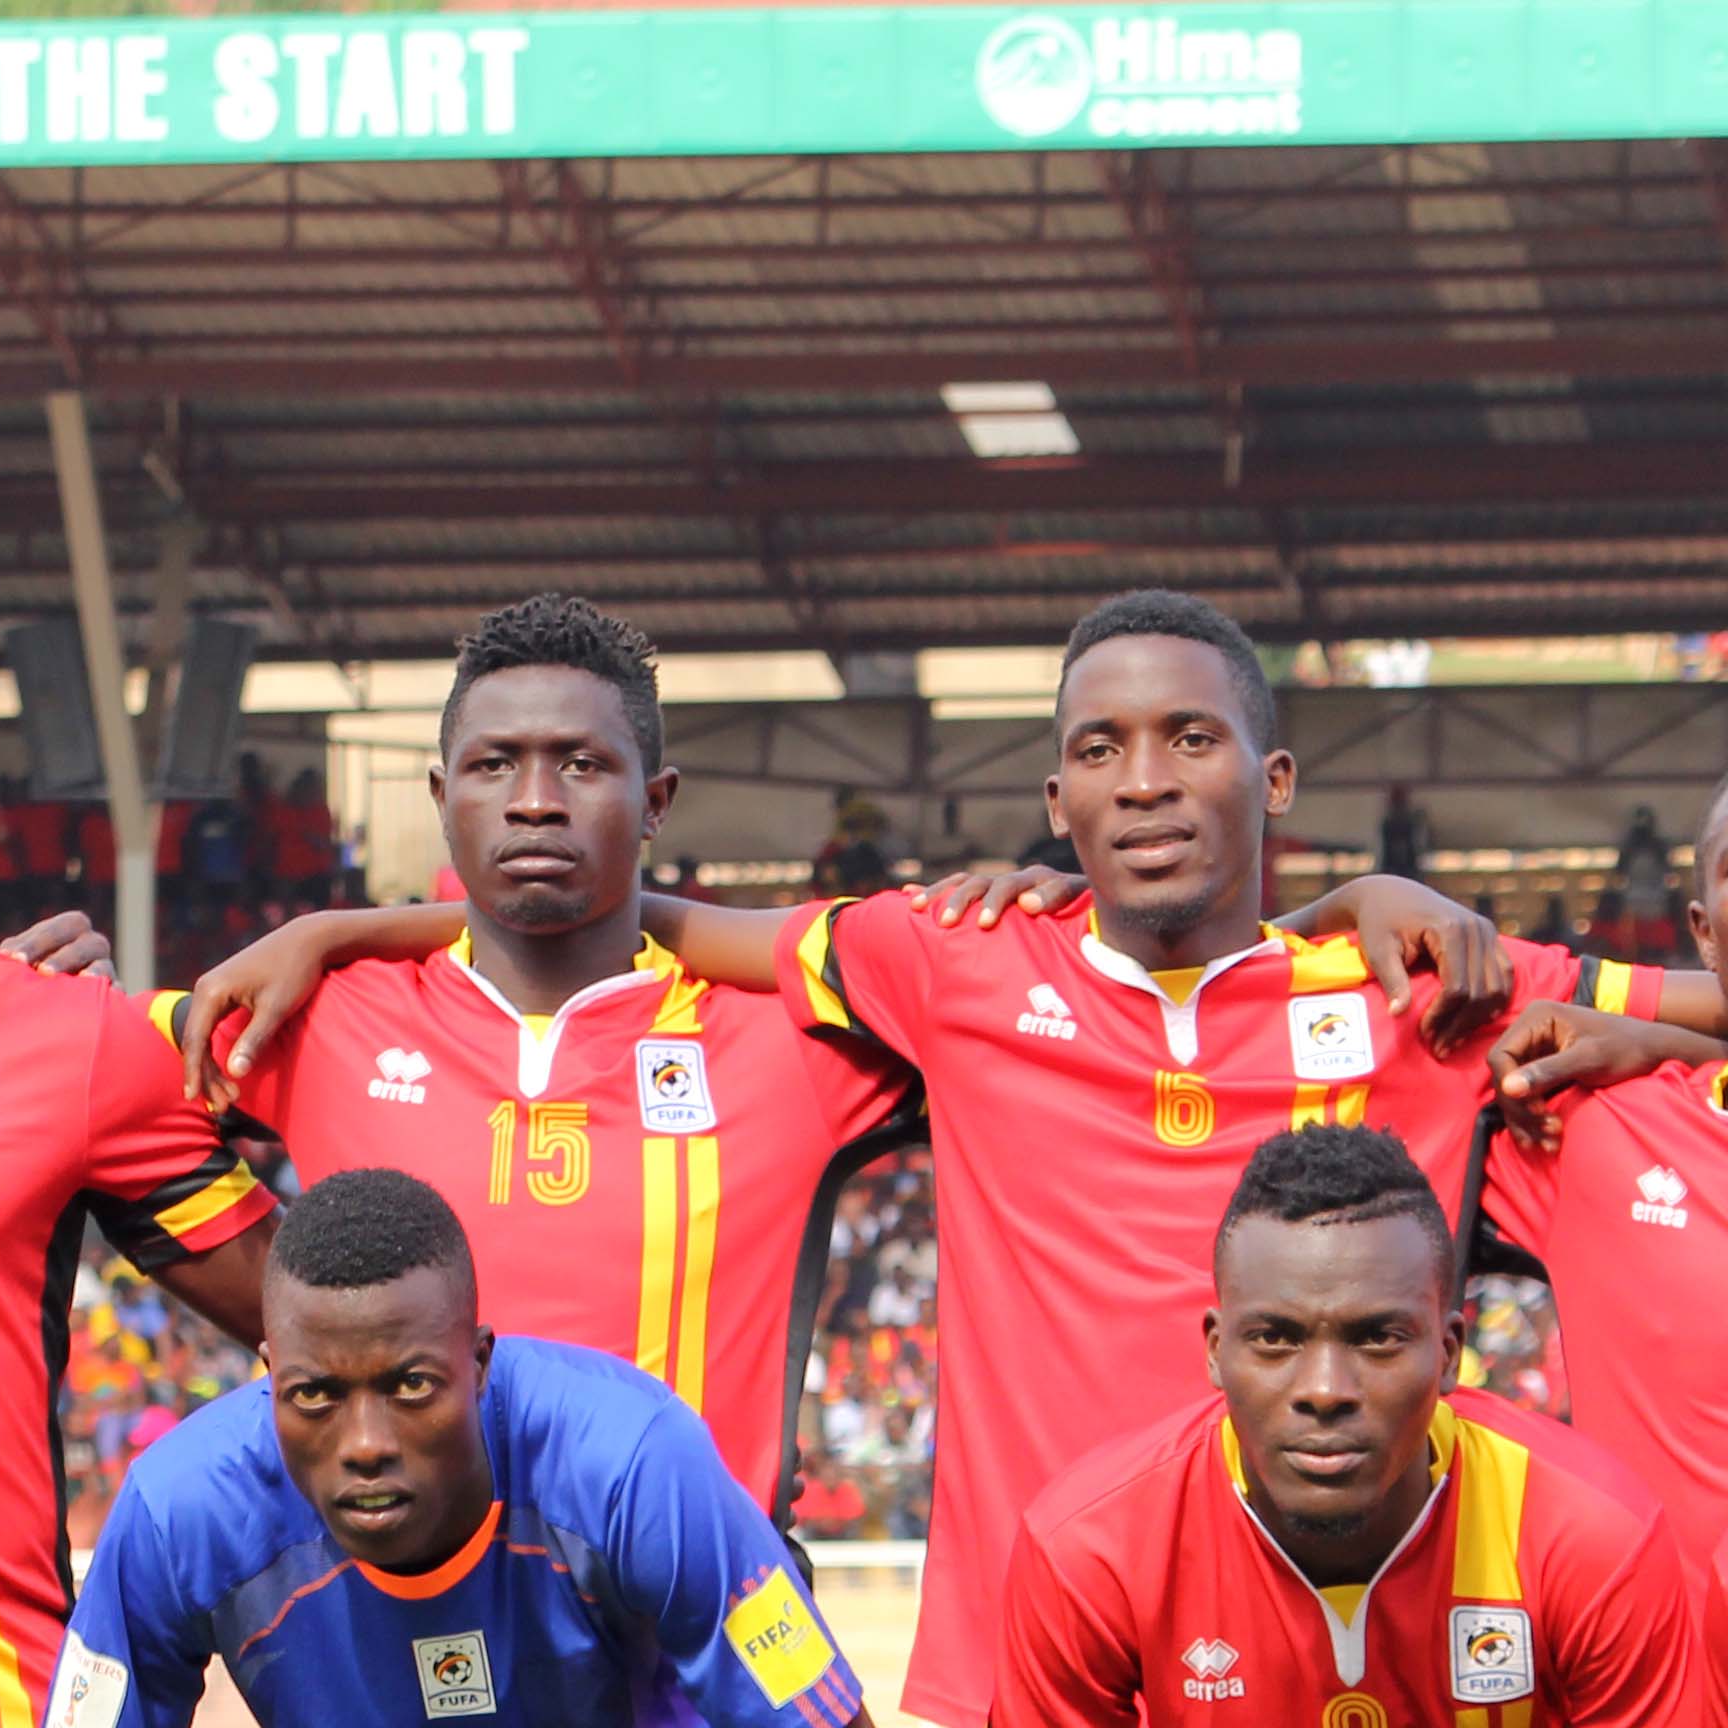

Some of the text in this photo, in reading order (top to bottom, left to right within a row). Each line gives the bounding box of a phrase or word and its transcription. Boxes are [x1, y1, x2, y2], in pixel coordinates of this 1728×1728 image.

[1091, 18, 1302, 84] Hima
[212, 27, 530, 143] START
[1088, 92, 1303, 137] cement
[657, 1109, 697, 1122] FUFA
[1154, 1069, 1215, 1146] 6
[487, 1100, 590, 1205] 15
[744, 1619, 794, 1659] FIFA
[439, 1694, 479, 1707] FUFA
[1469, 1677, 1515, 1691] FUFA
